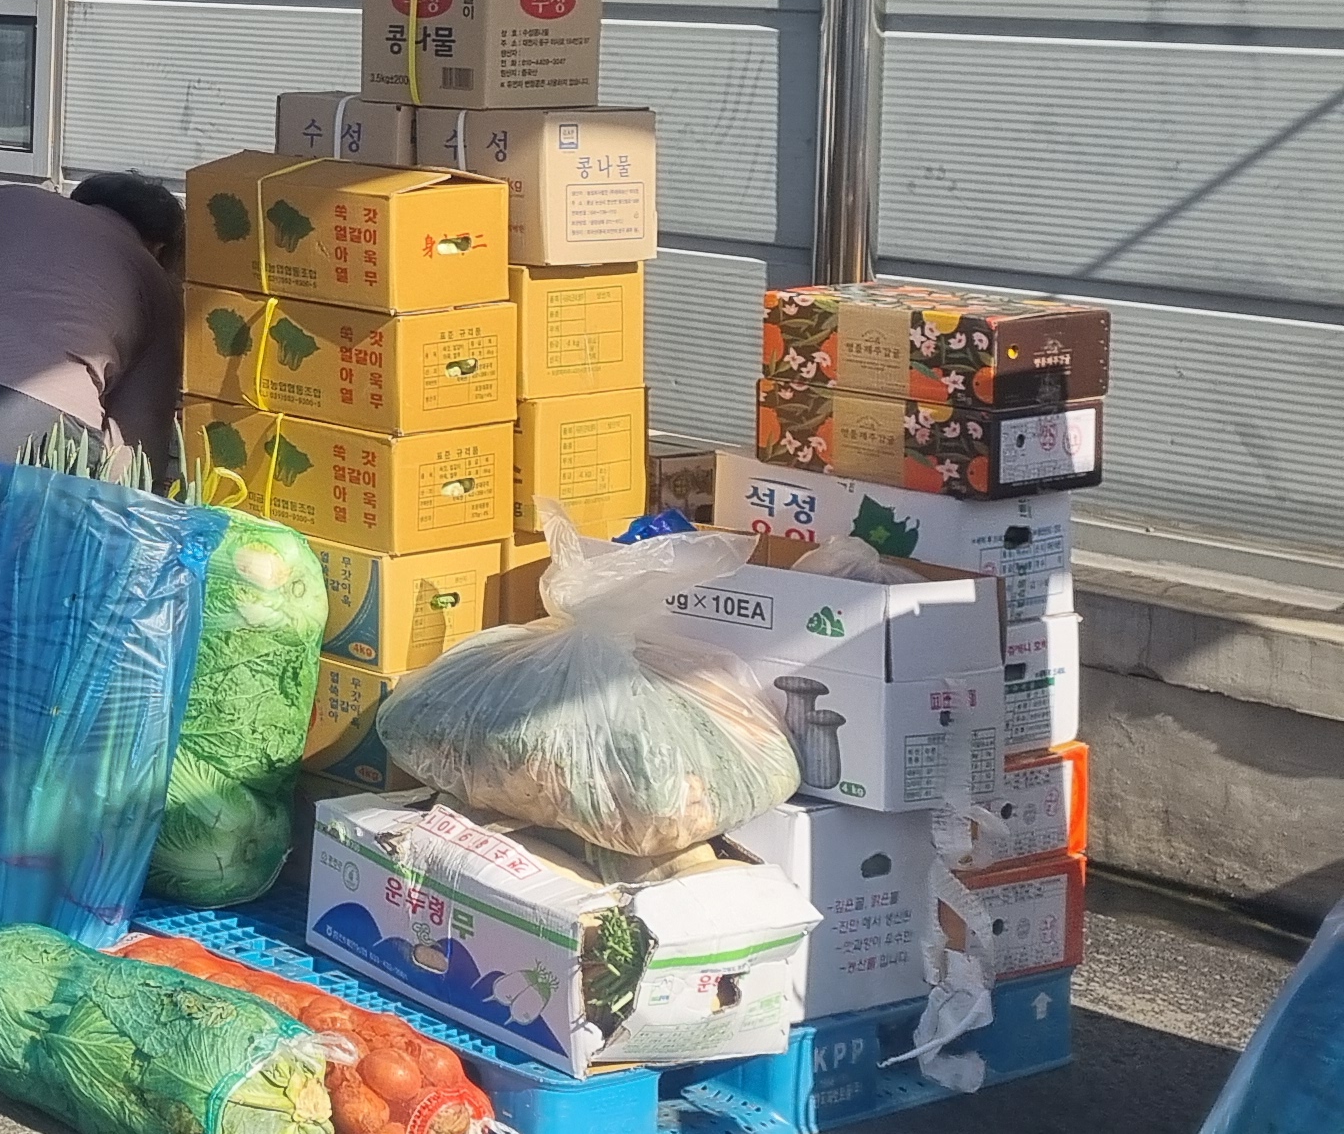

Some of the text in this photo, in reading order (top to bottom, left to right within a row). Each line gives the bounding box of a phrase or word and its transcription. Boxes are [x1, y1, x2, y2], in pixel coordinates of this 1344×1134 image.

[385, 24, 456, 58] 콩나물
[576, 155, 632, 179] 콩나물
[423, 233, 488, 258] 身二
[745, 485, 817, 524] 석성
[451, 907, 475, 940] 무
[814, 1037, 864, 1073] KPP
